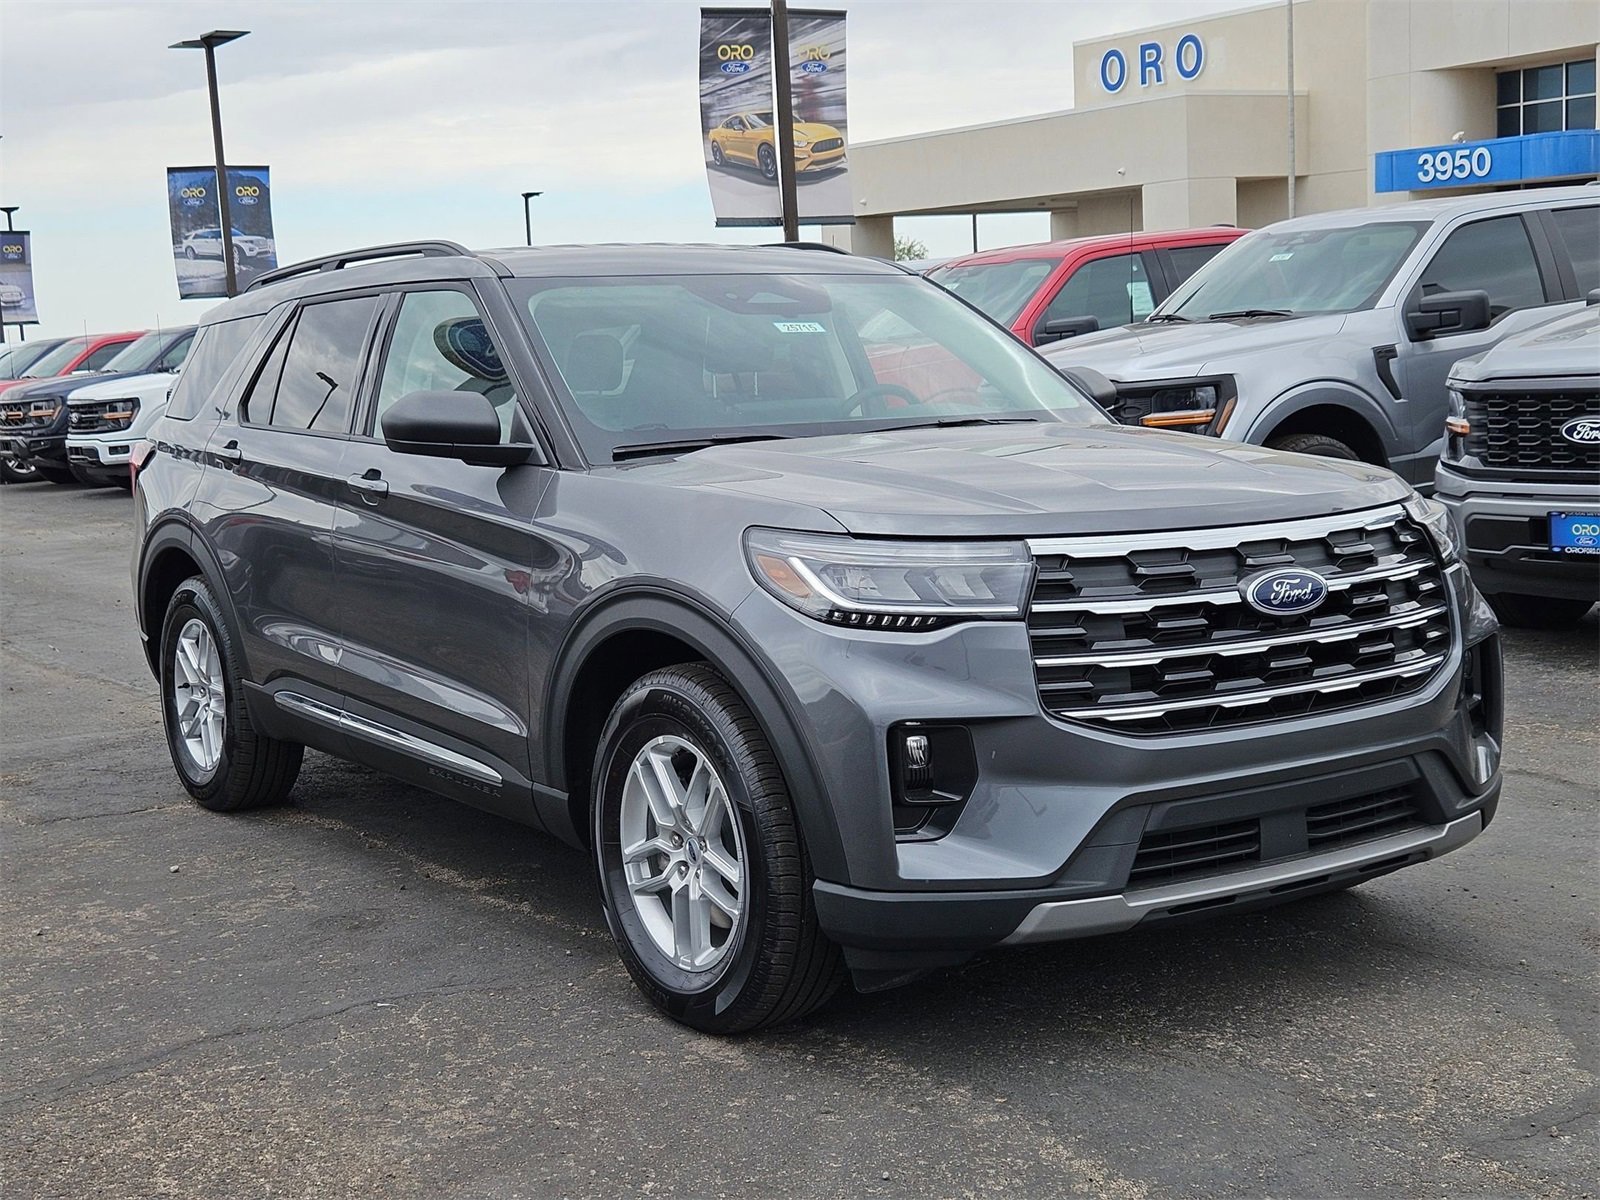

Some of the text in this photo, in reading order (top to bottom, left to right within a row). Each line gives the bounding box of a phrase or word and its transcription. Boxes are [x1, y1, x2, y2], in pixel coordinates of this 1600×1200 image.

[717, 44, 754, 60] ORO
[726, 63, 745, 73] Ford
[805, 62, 823, 73] Ford
[1100, 33, 1204, 94] ORO
[1417, 147, 1491, 183] 3950
[181, 187, 206, 198] ORO
[235, 186, 259, 197] ORO
[1573, 422, 1600, 440] For
[1572, 524, 1600, 536] ORO
[1271, 578, 1314, 605] Ford
